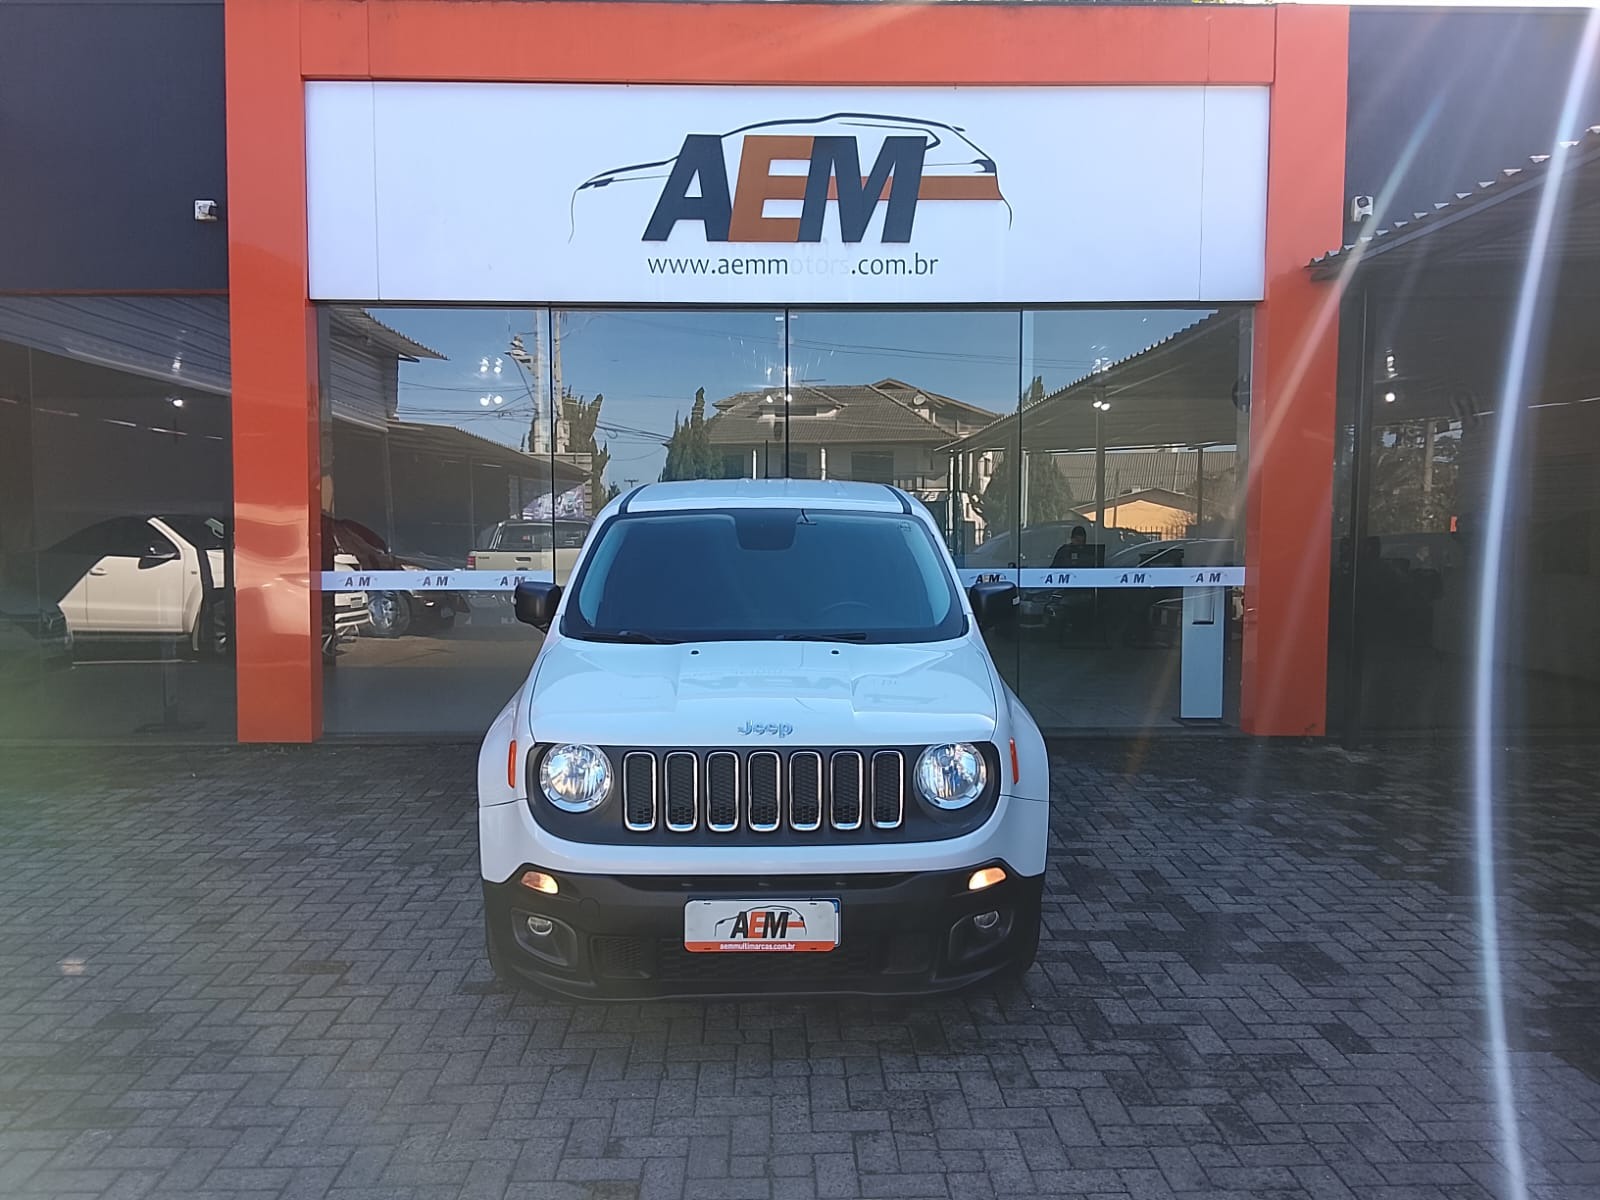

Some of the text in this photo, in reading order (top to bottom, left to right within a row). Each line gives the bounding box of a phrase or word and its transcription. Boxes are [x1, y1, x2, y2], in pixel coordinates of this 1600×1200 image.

[641, 133, 928, 243] AEM
[737, 720, 794, 739] Jeep
[730, 911, 790, 939] AEM
